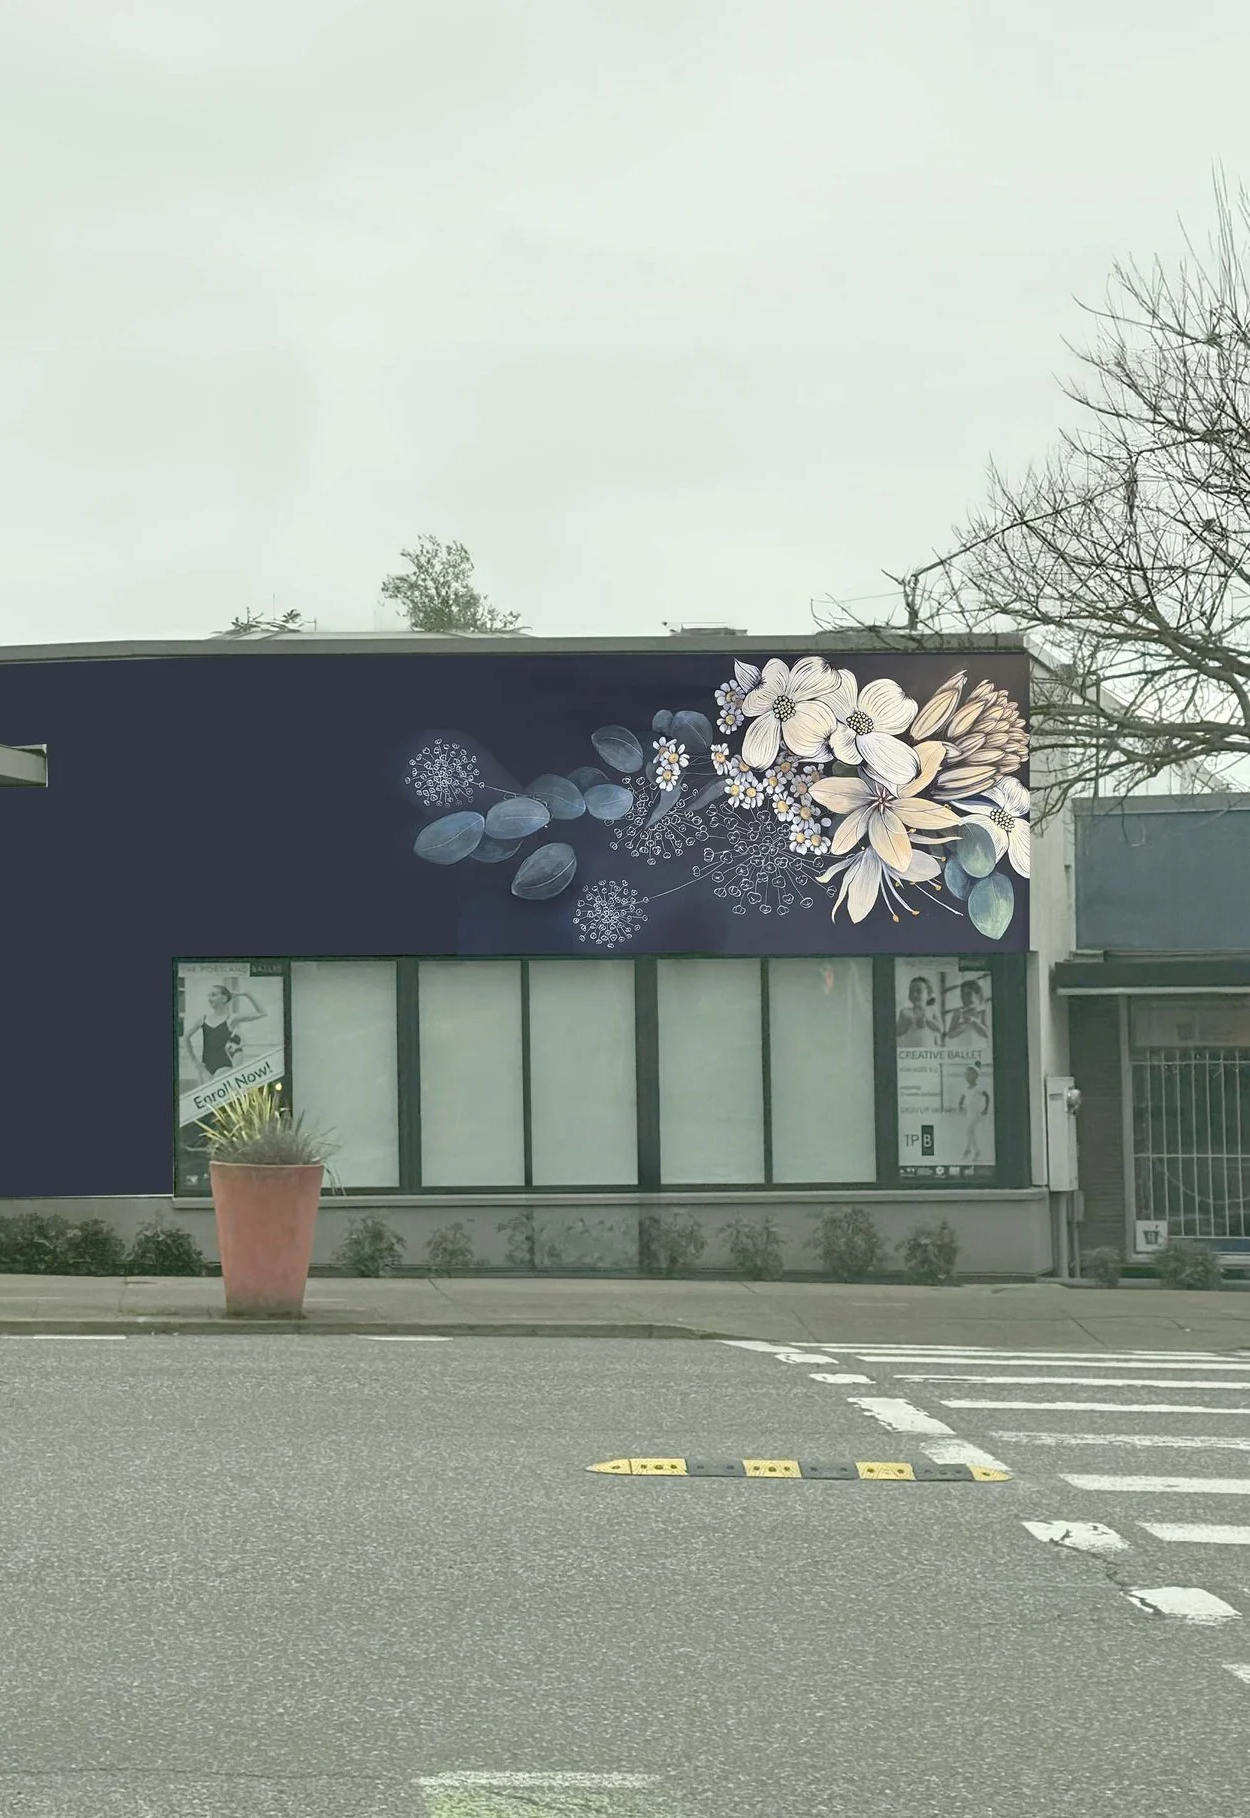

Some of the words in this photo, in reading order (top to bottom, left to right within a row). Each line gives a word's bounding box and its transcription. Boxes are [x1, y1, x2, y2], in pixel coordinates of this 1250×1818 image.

[898, 1050, 945, 1060] CREATIVE
[947, 1050, 982, 1060] BALLET
[193, 1080, 232, 1110] Enroll
[234, 1061, 273, 1089] Now!
